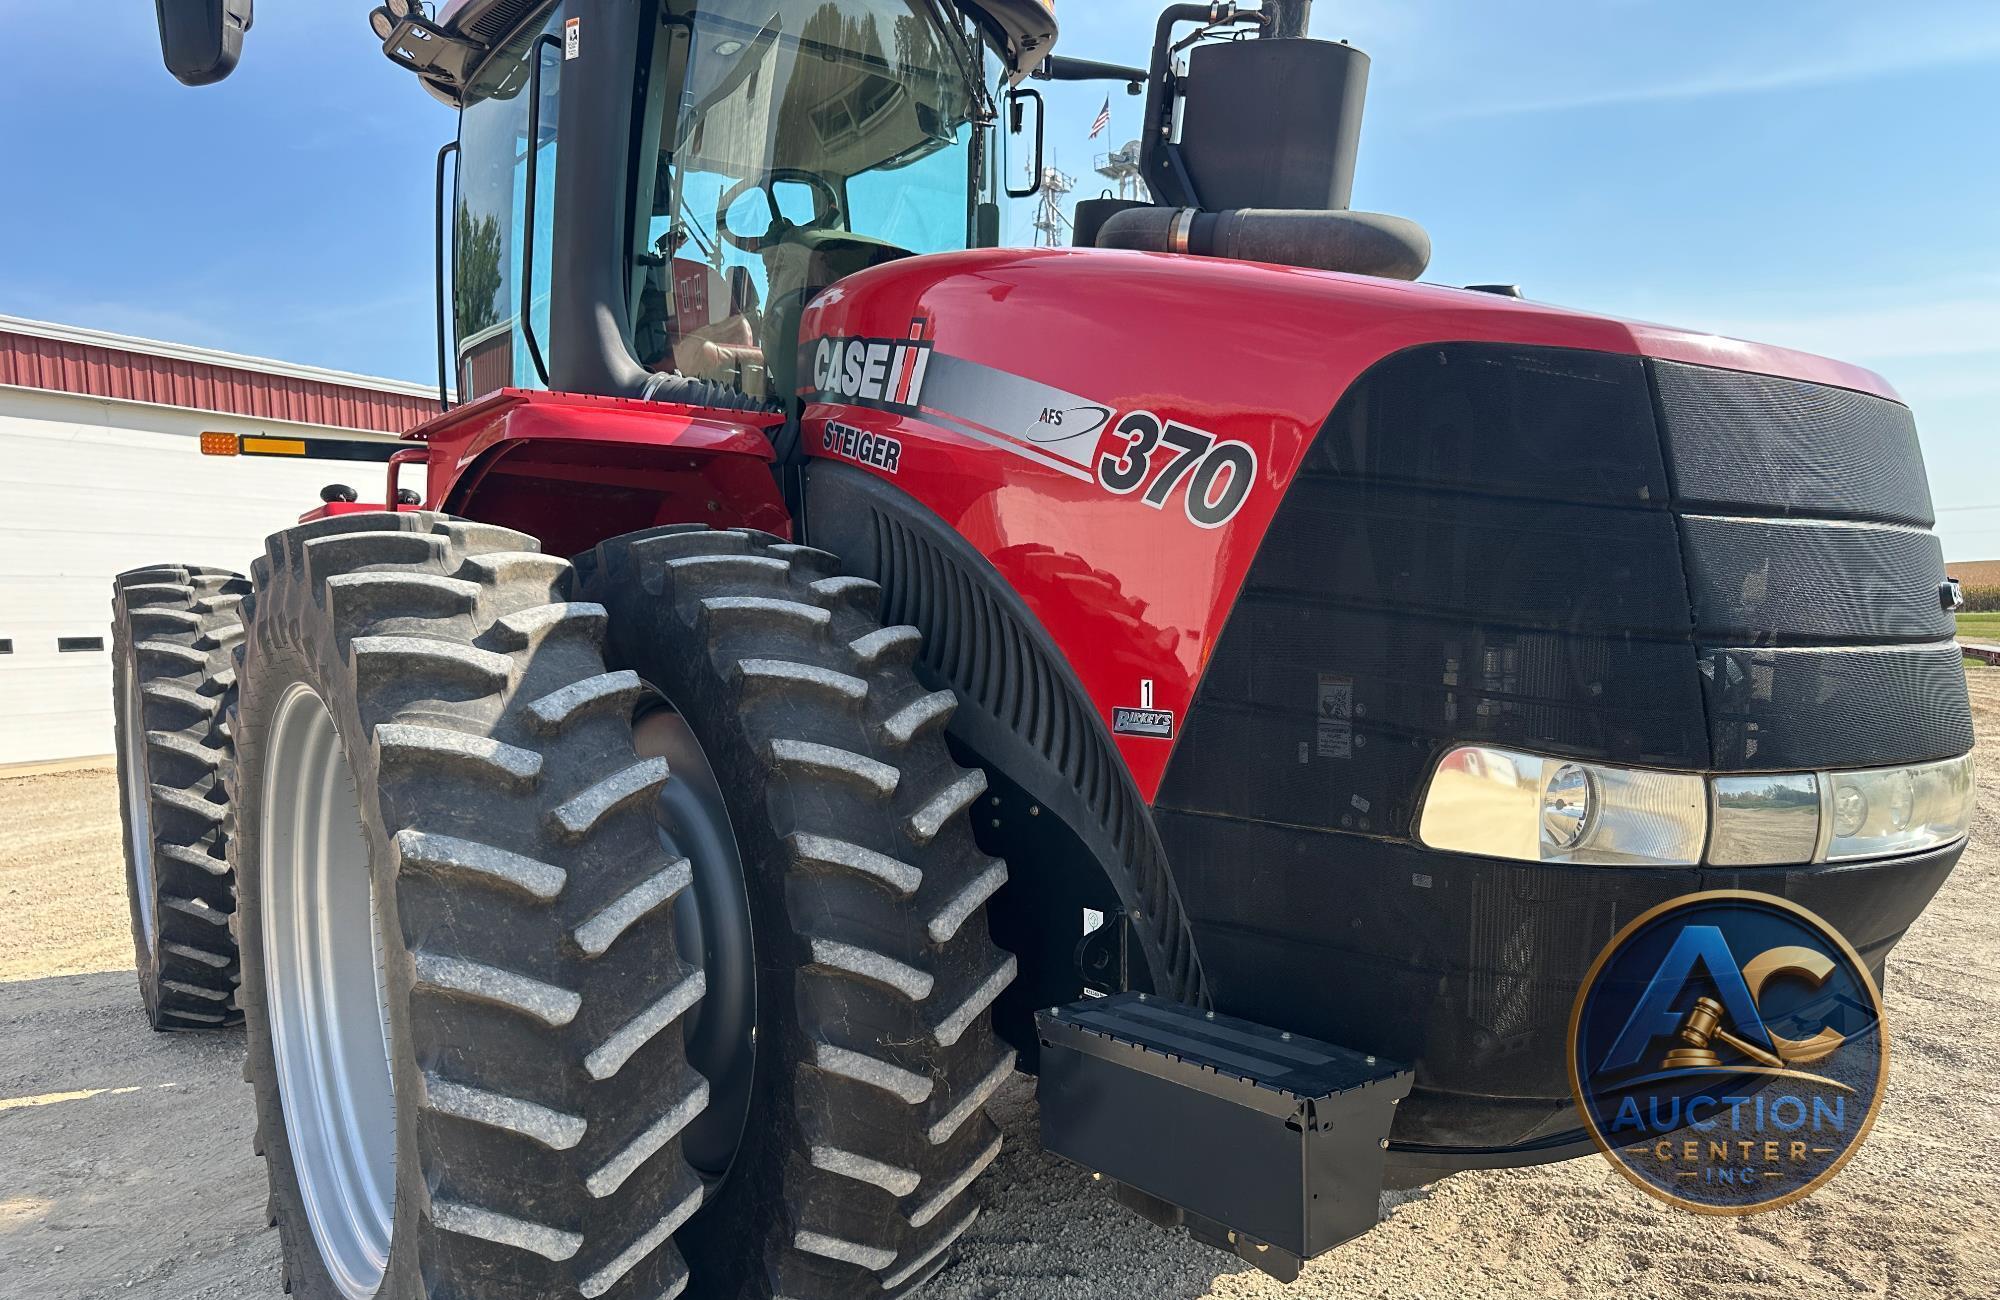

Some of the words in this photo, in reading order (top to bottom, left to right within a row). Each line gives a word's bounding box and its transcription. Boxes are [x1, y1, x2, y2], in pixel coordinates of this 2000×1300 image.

[1039, 408, 1063, 426] AFS
[823, 419, 901, 474] STEIGER
[1098, 410, 1258, 529] 370
